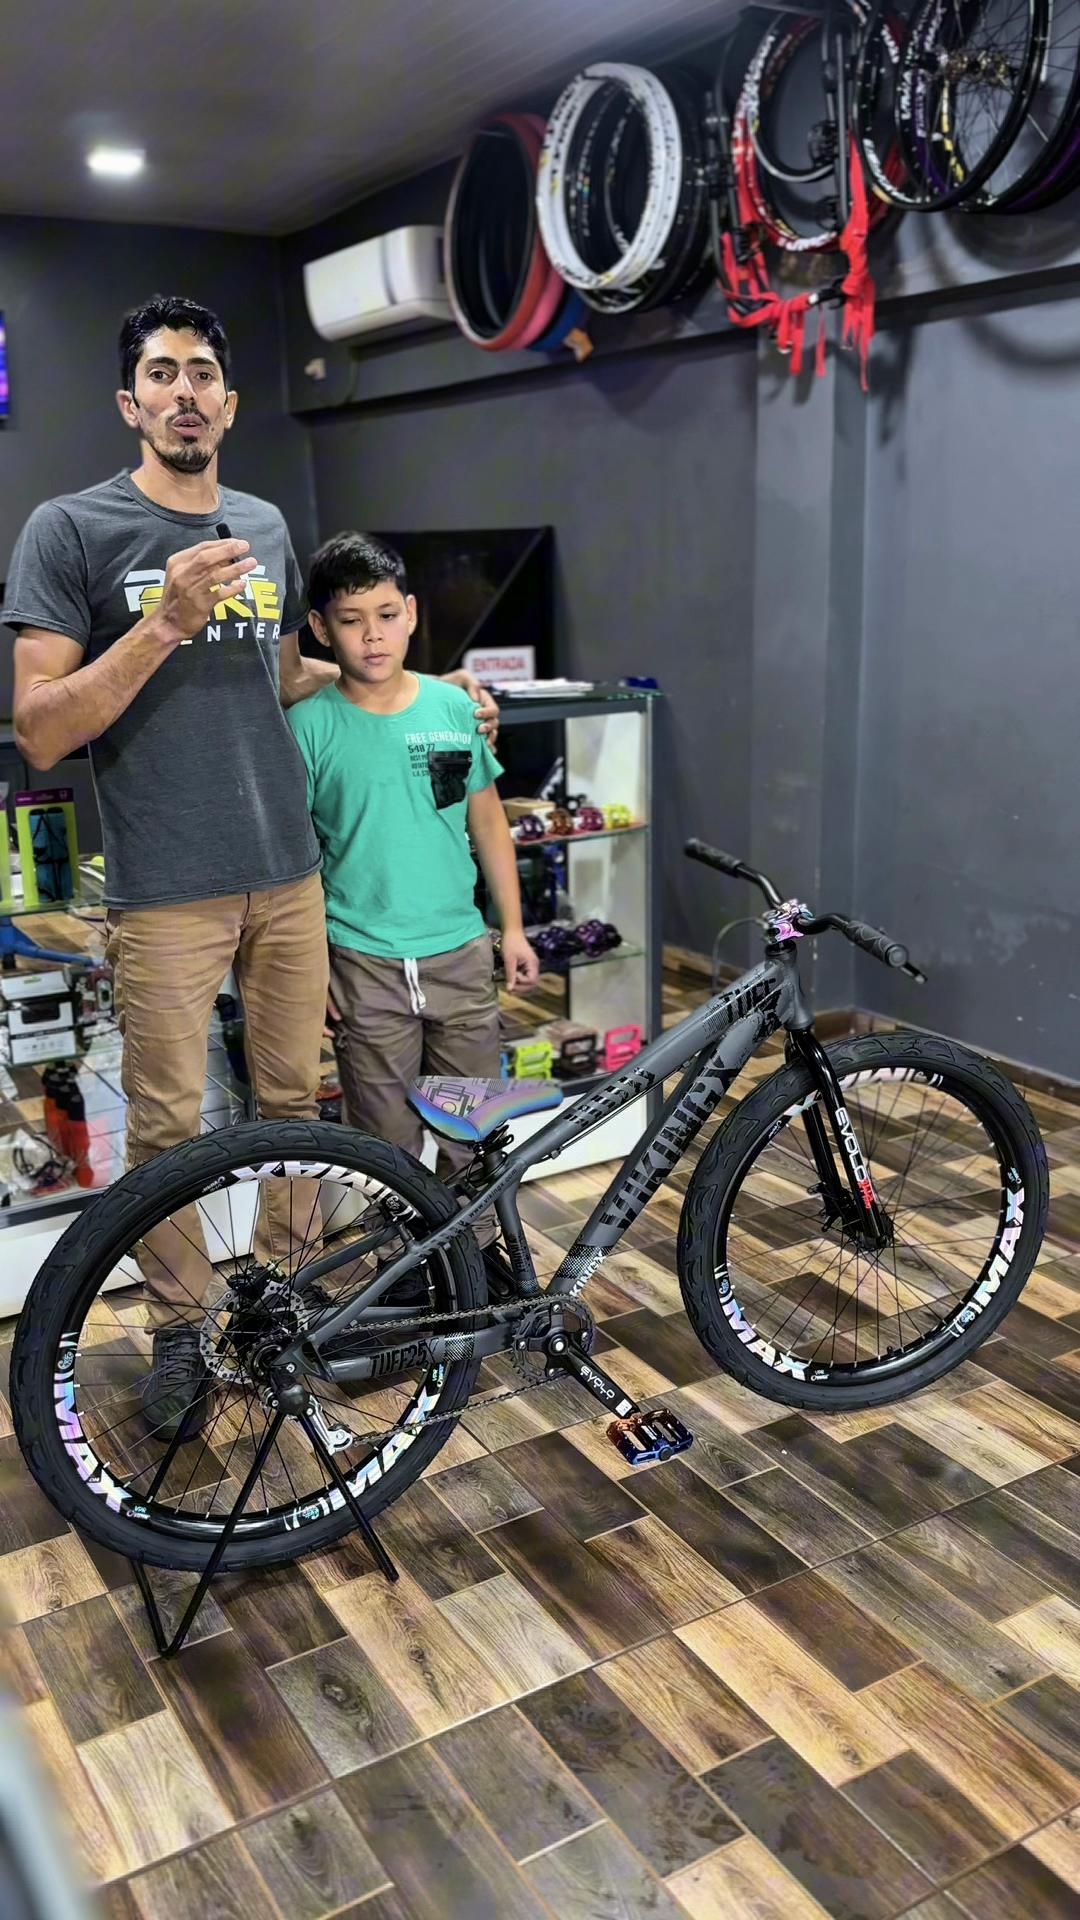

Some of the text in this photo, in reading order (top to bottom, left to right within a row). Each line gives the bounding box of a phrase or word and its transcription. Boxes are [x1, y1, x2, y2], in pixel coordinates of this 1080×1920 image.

[180, 621, 280, 645] NTER
[405, 731, 426, 744] FREE
[599, 1049, 743, 1232] VIKINGX
[835, 1106, 867, 1183] EVOLO
[580, 1365, 616, 1400] EVOLO
